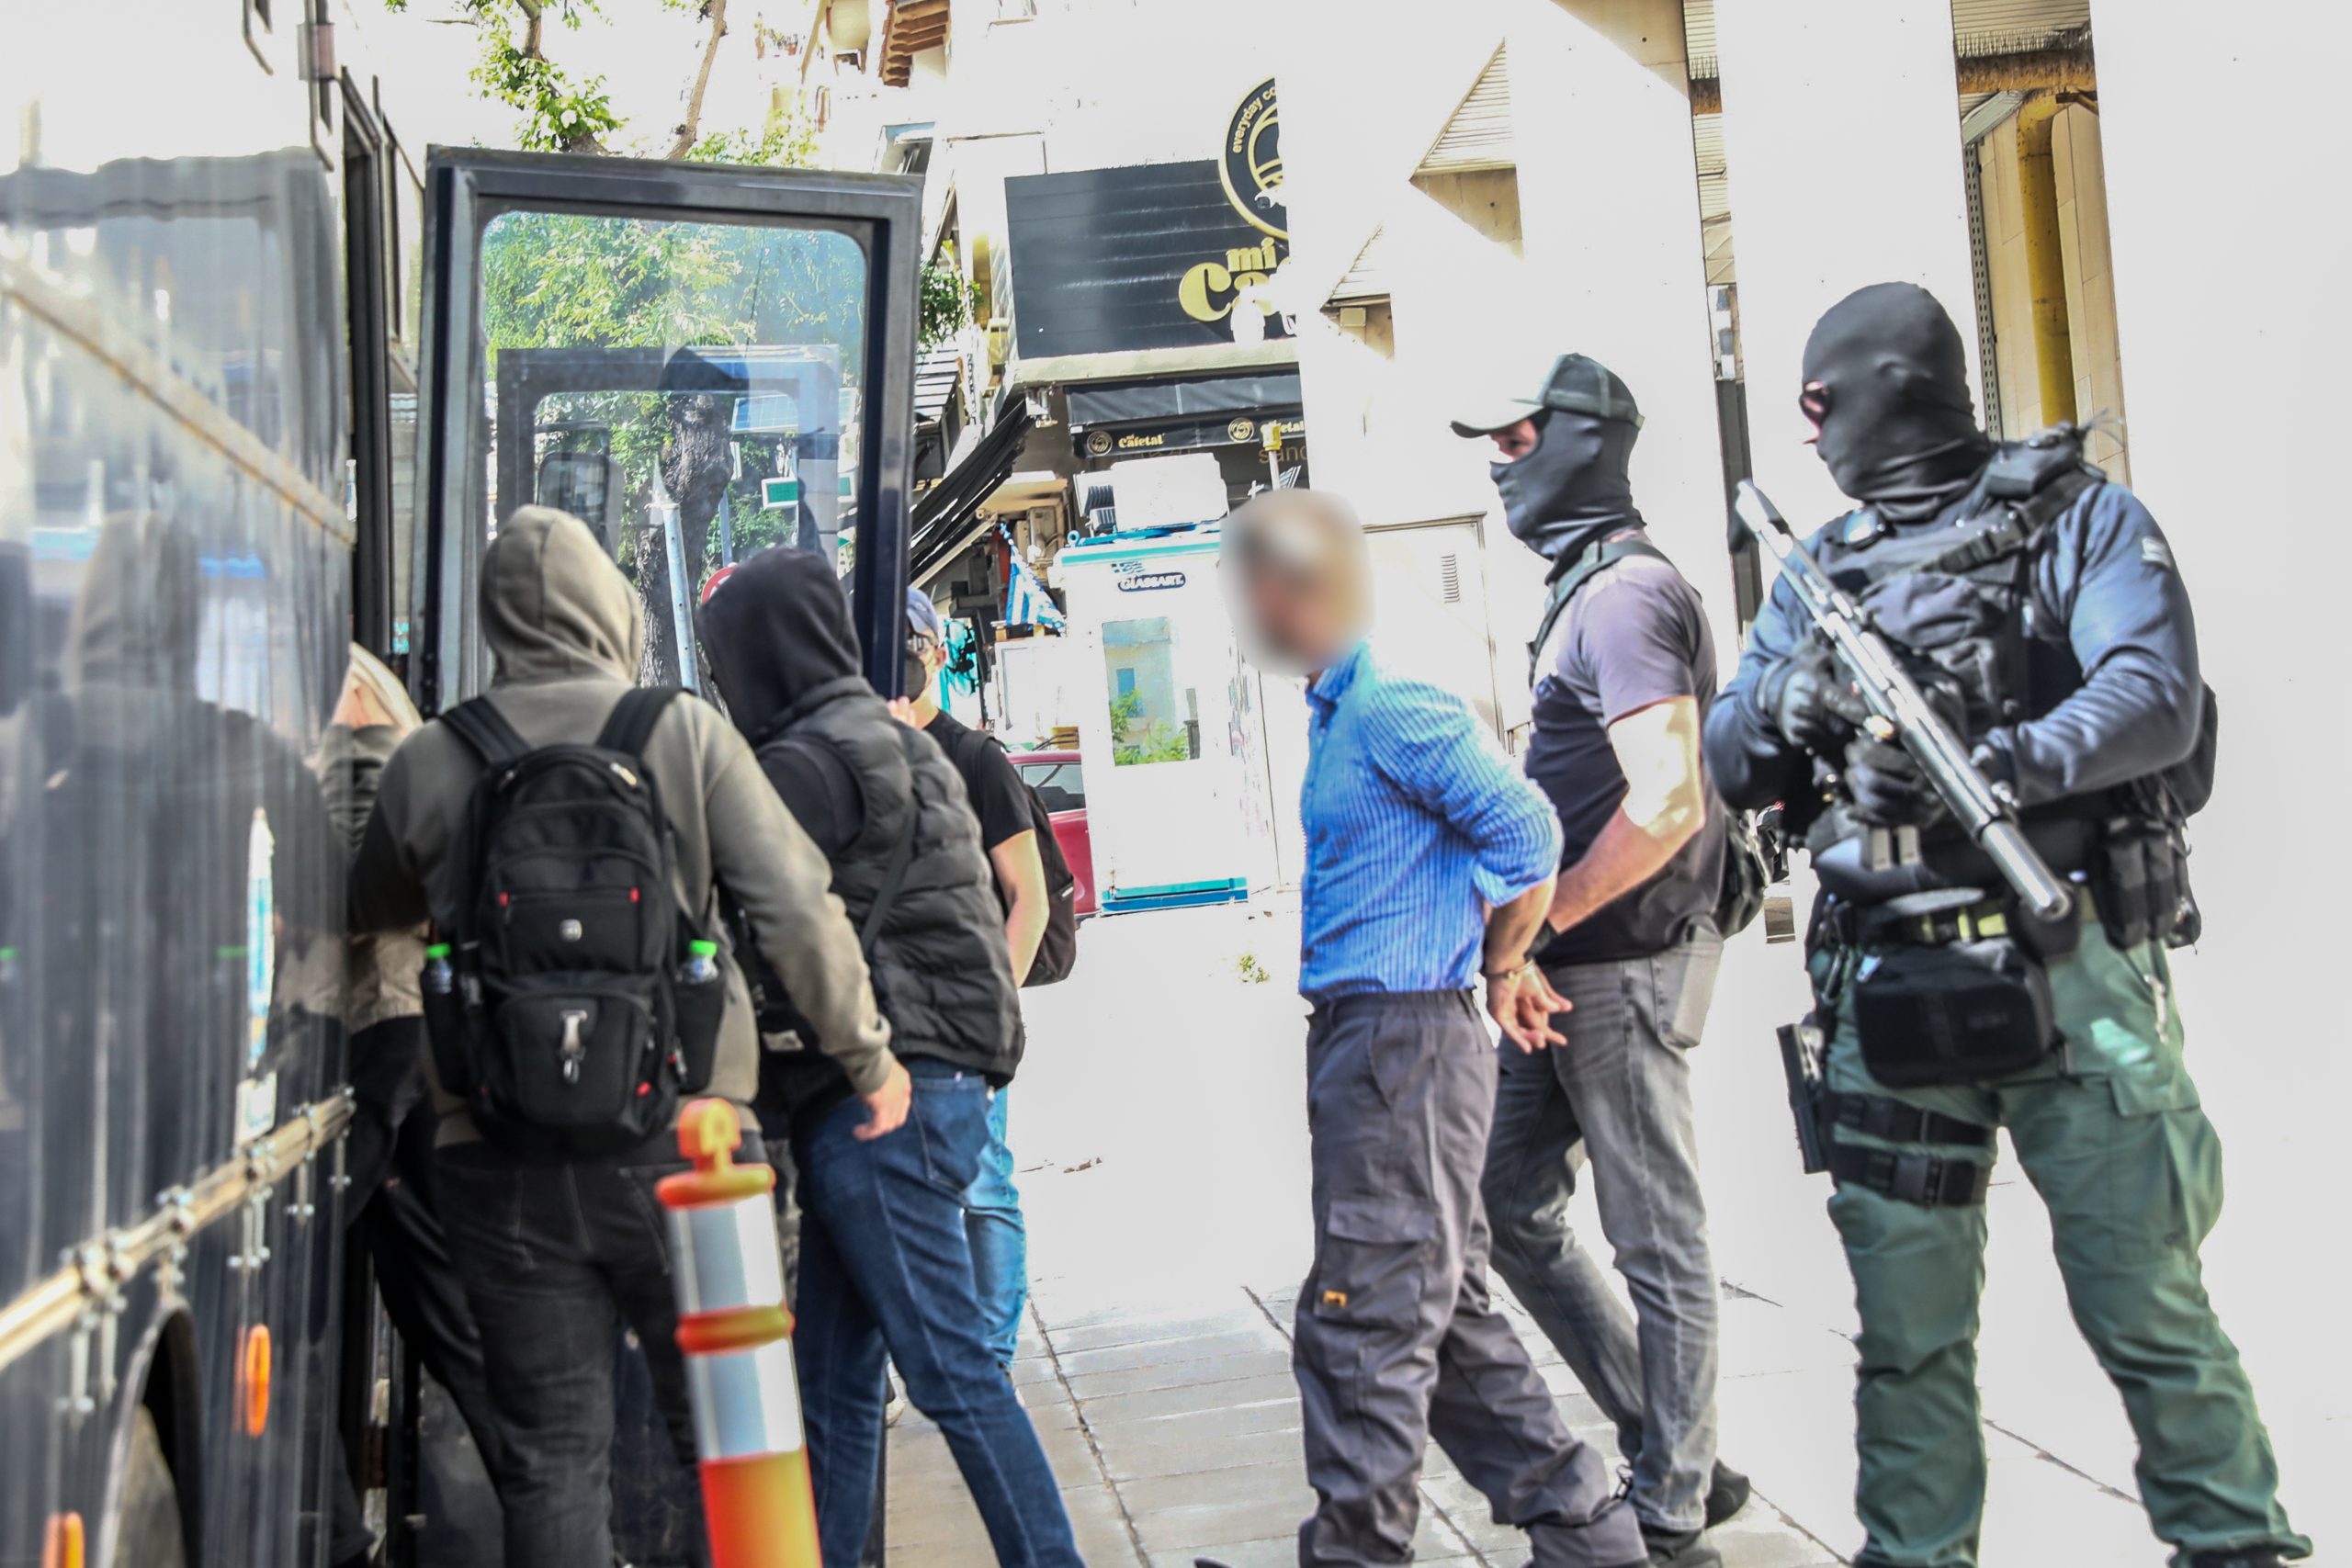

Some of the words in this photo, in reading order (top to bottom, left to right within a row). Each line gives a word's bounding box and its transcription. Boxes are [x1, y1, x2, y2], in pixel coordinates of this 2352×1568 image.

[1232, 96, 1263, 153] everyday
[1226, 237, 1277, 273] mi
[1118, 434, 1164, 448] Cafetal
